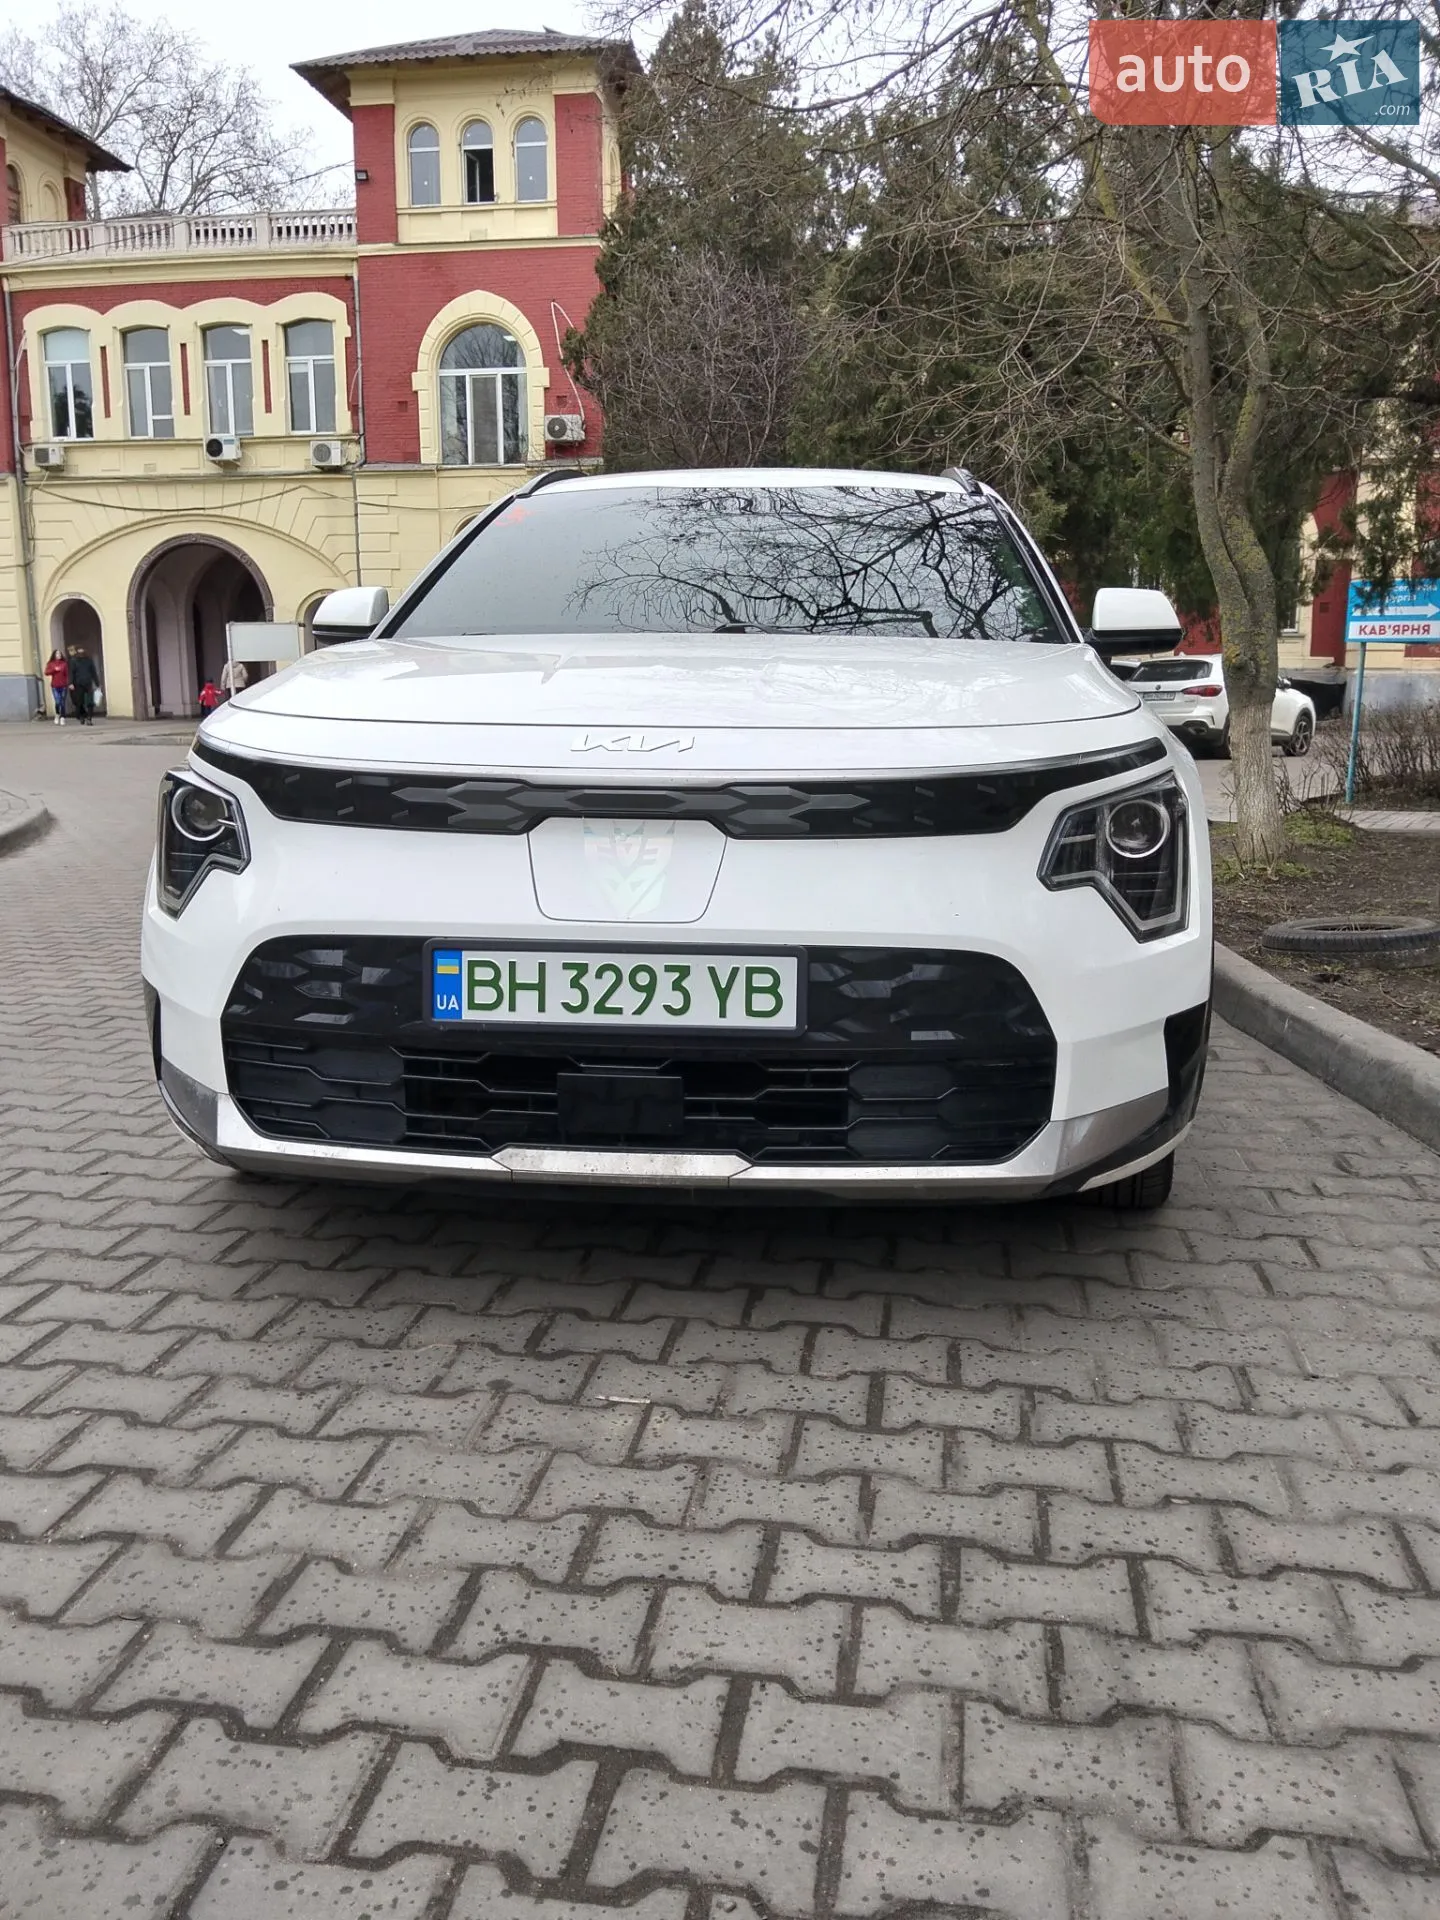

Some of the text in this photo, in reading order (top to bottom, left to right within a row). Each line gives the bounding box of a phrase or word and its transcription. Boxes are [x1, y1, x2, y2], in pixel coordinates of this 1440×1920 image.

[1358, 624, 1431, 636] КАВ'ЯРНЯ
[570, 733, 695, 753] KIA
[466, 959, 784, 1019] BH 3293 YB
[436, 994, 459, 1011] UA
